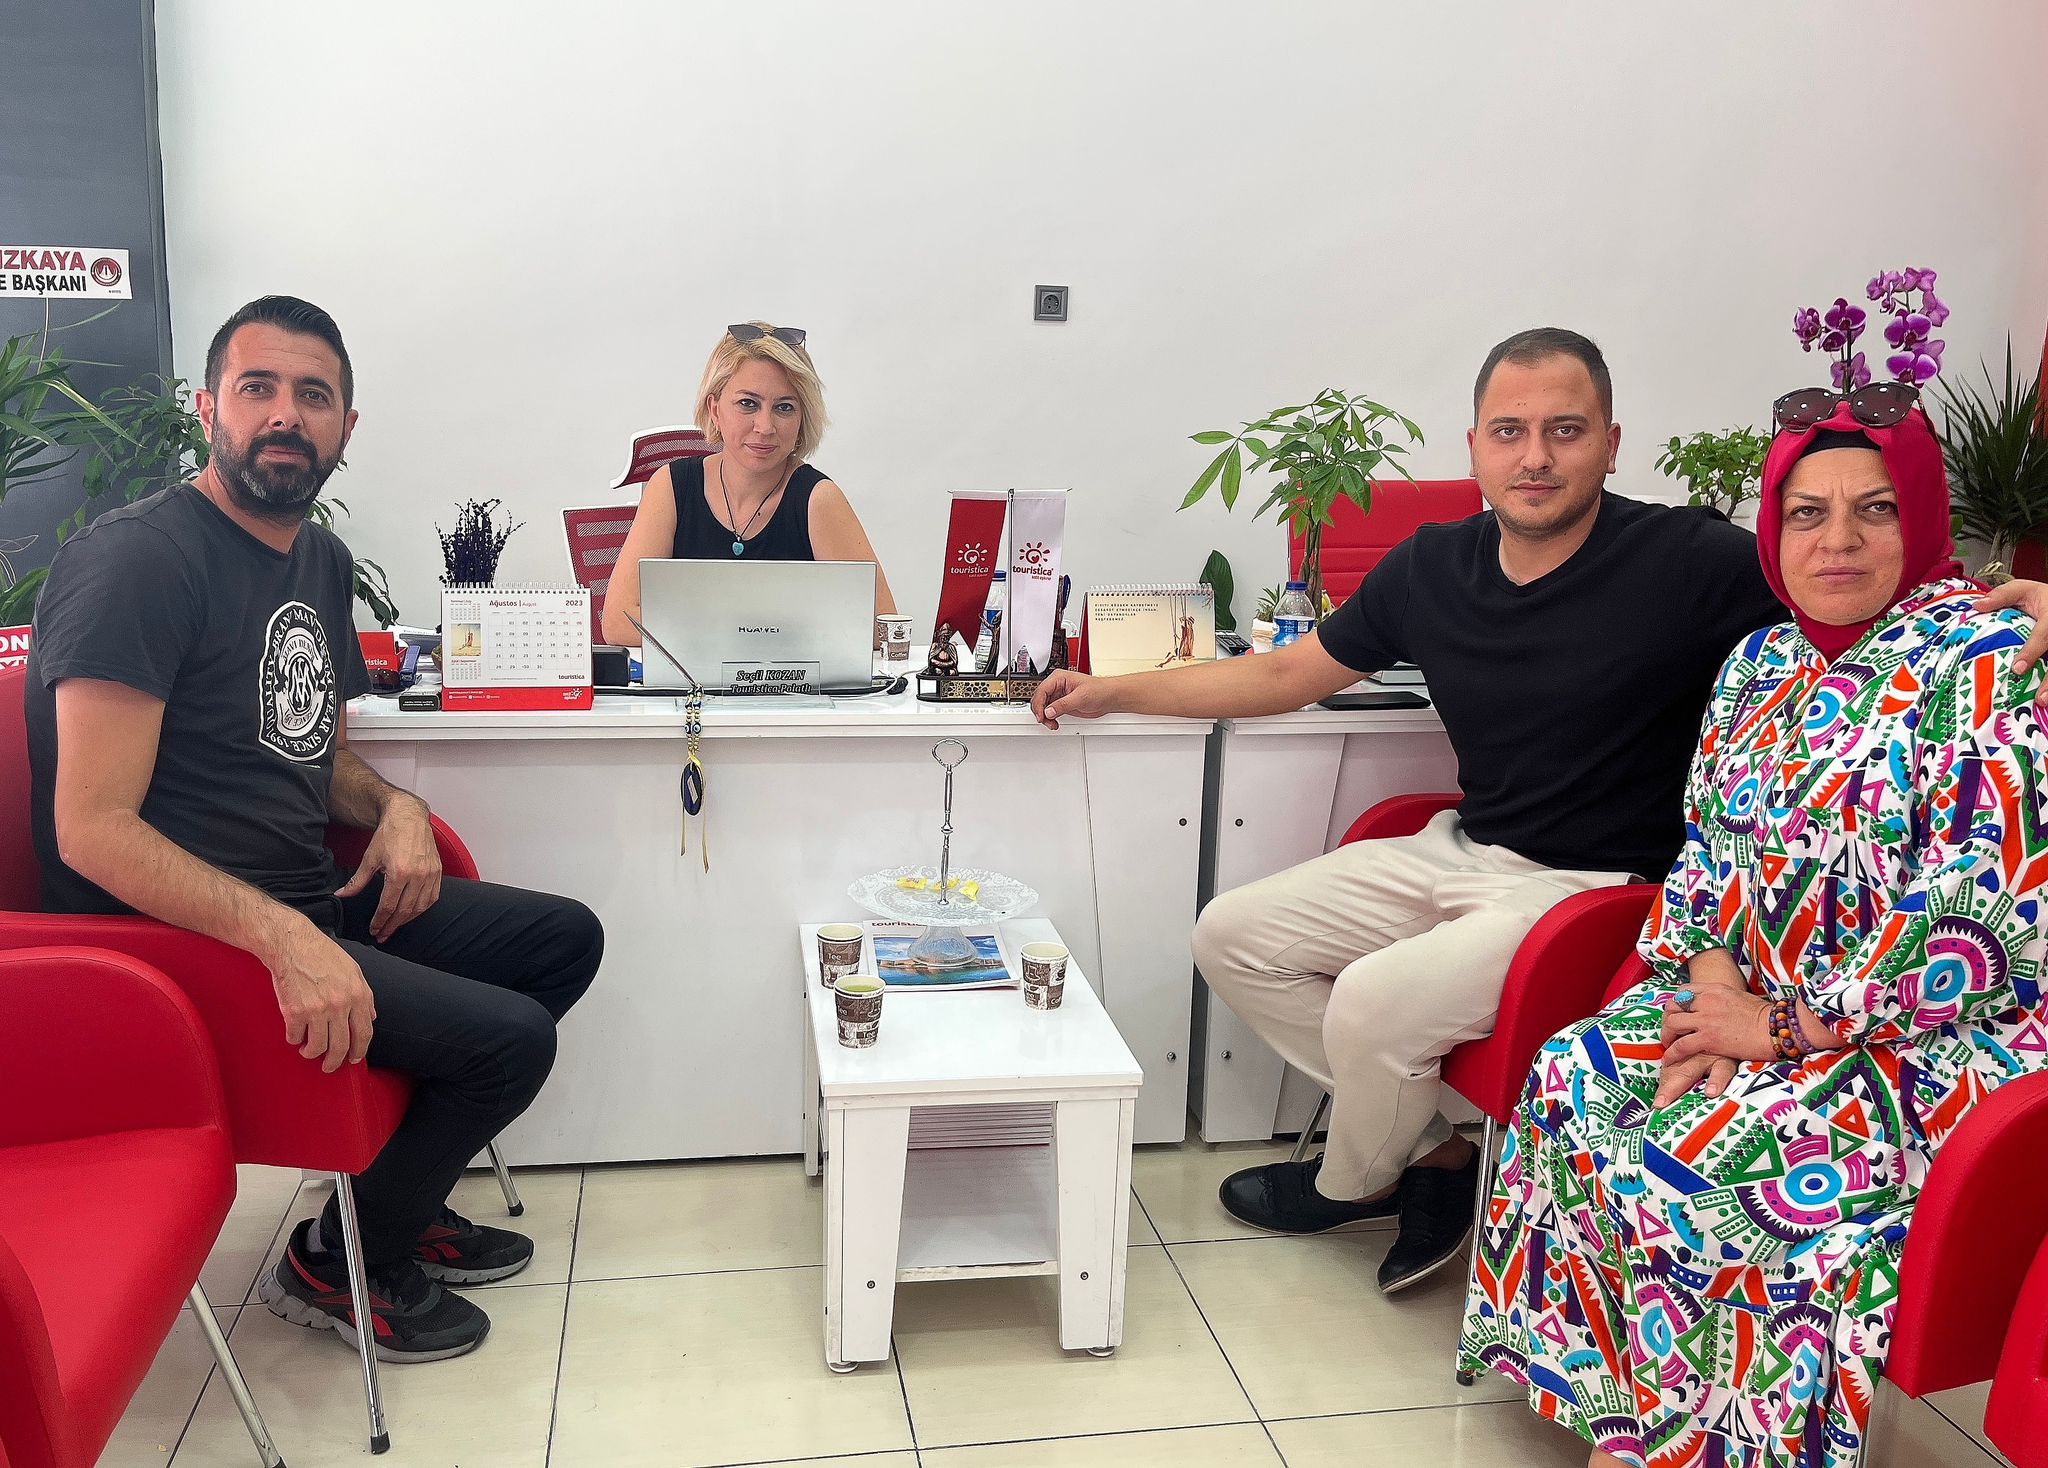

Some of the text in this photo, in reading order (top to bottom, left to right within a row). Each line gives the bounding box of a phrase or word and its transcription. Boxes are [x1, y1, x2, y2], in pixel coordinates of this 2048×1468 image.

[12, 275, 87, 295] BAŞKANI
[951, 563, 989, 574] touristica
[1013, 564, 1053, 576] touristica
[272, 611, 292, 650] BRAN
[736, 670, 806, 683] Seçil KOZAN
[730, 684, 780, 693] Touristica
[319, 690, 335, 734] WEAR
[266, 728, 289, 748] 1991
[290, 732, 322, 752] SINCE
